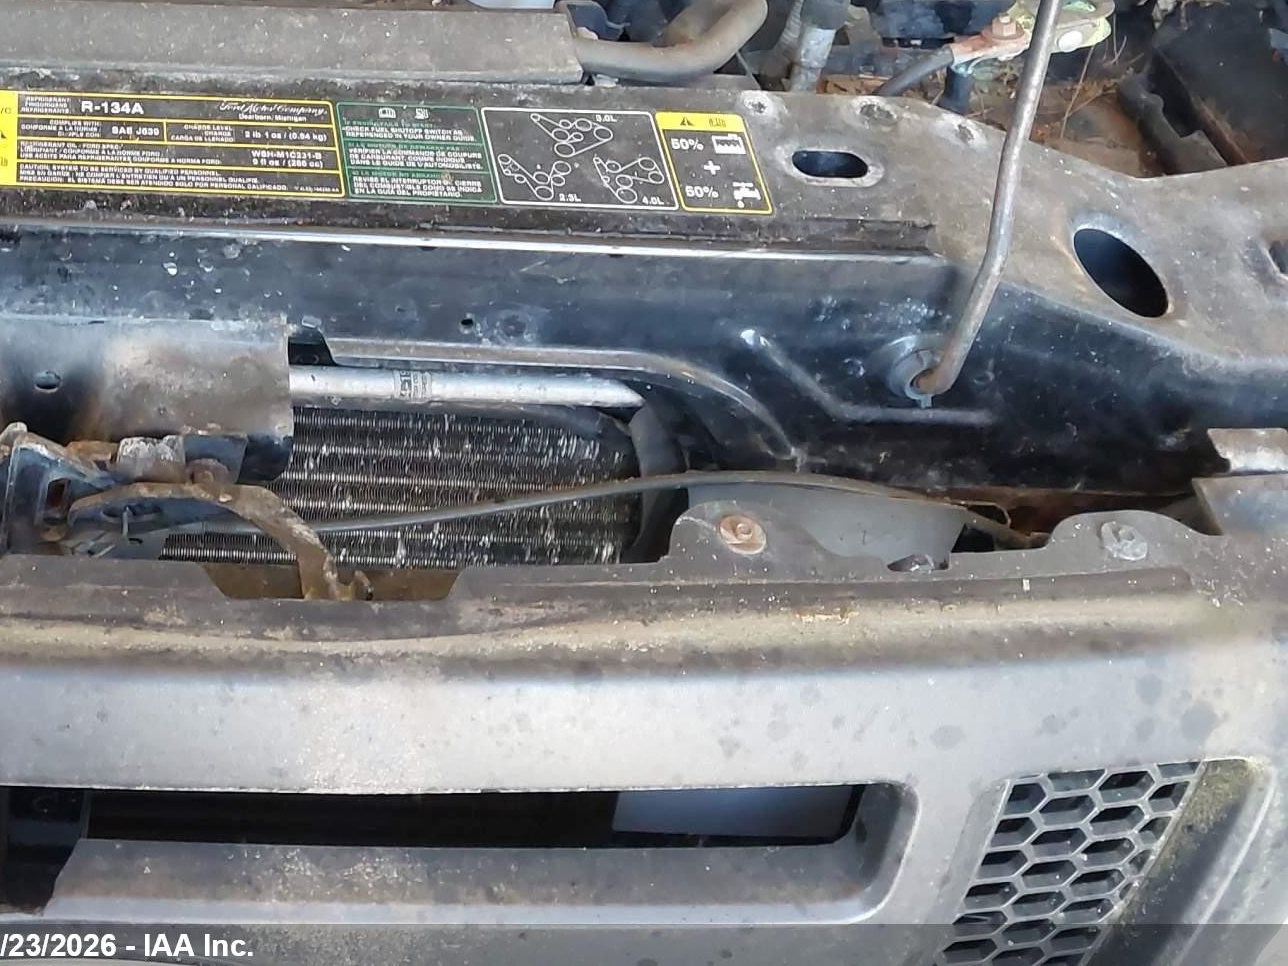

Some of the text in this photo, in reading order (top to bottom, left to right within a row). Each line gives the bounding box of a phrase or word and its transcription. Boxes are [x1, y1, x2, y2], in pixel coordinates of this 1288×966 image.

[81, 100, 145, 115] R-134A
[219, 101, 245, 111] Ford
[247, 103, 276, 114] Motor
[595, 114, 617, 123] 3.0L
[111, 126, 133, 135] SAE
[253, 130, 261, 139] lb
[312, 133, 327, 142] kg)
[670, 137, 704, 151] 50%
[559, 193, 581, 203] 2.3L
[685, 185, 719, 199] 50%
[642, 196, 664, 205] 4.0L
